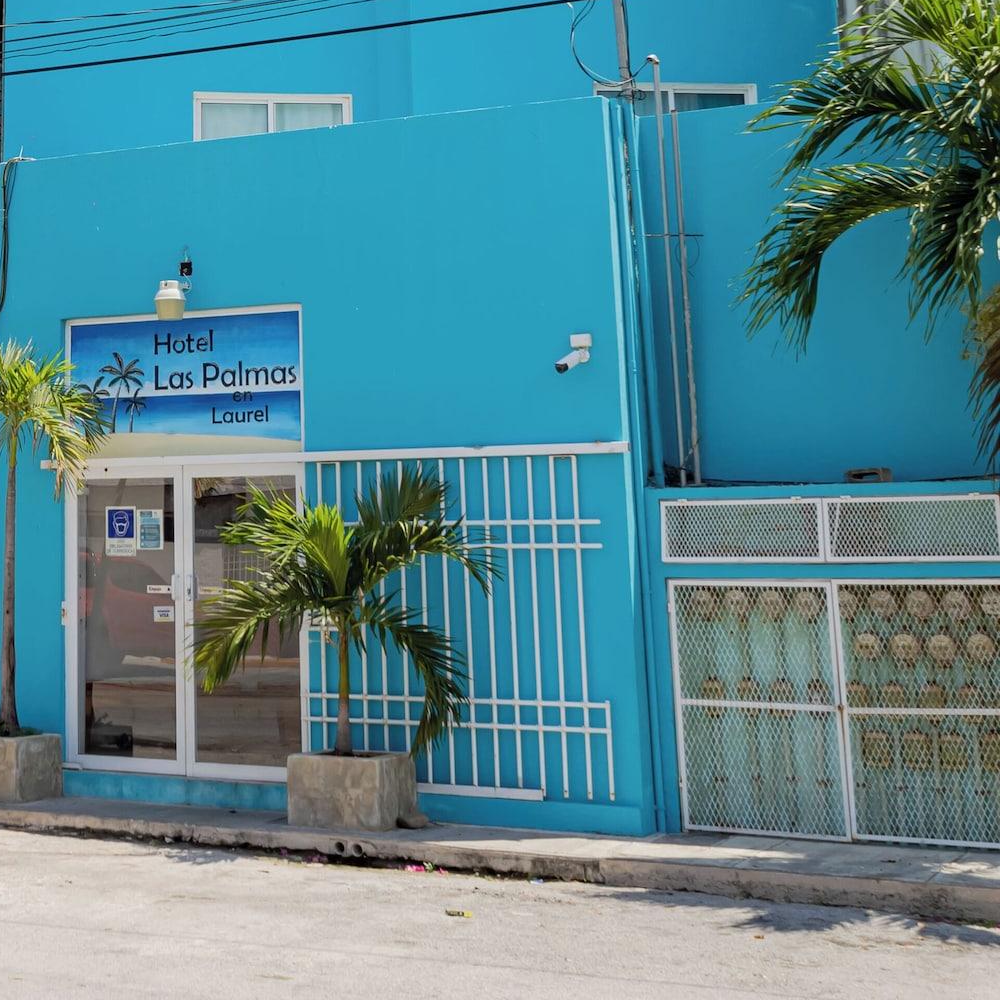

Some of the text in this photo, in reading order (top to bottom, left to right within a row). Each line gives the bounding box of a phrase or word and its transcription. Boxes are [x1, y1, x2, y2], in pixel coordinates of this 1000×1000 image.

[154, 329, 214, 355] Hotel
[154, 360, 297, 391] Las Palmas
[232, 390, 253, 403] en
[212, 405, 269, 425] Laurel
